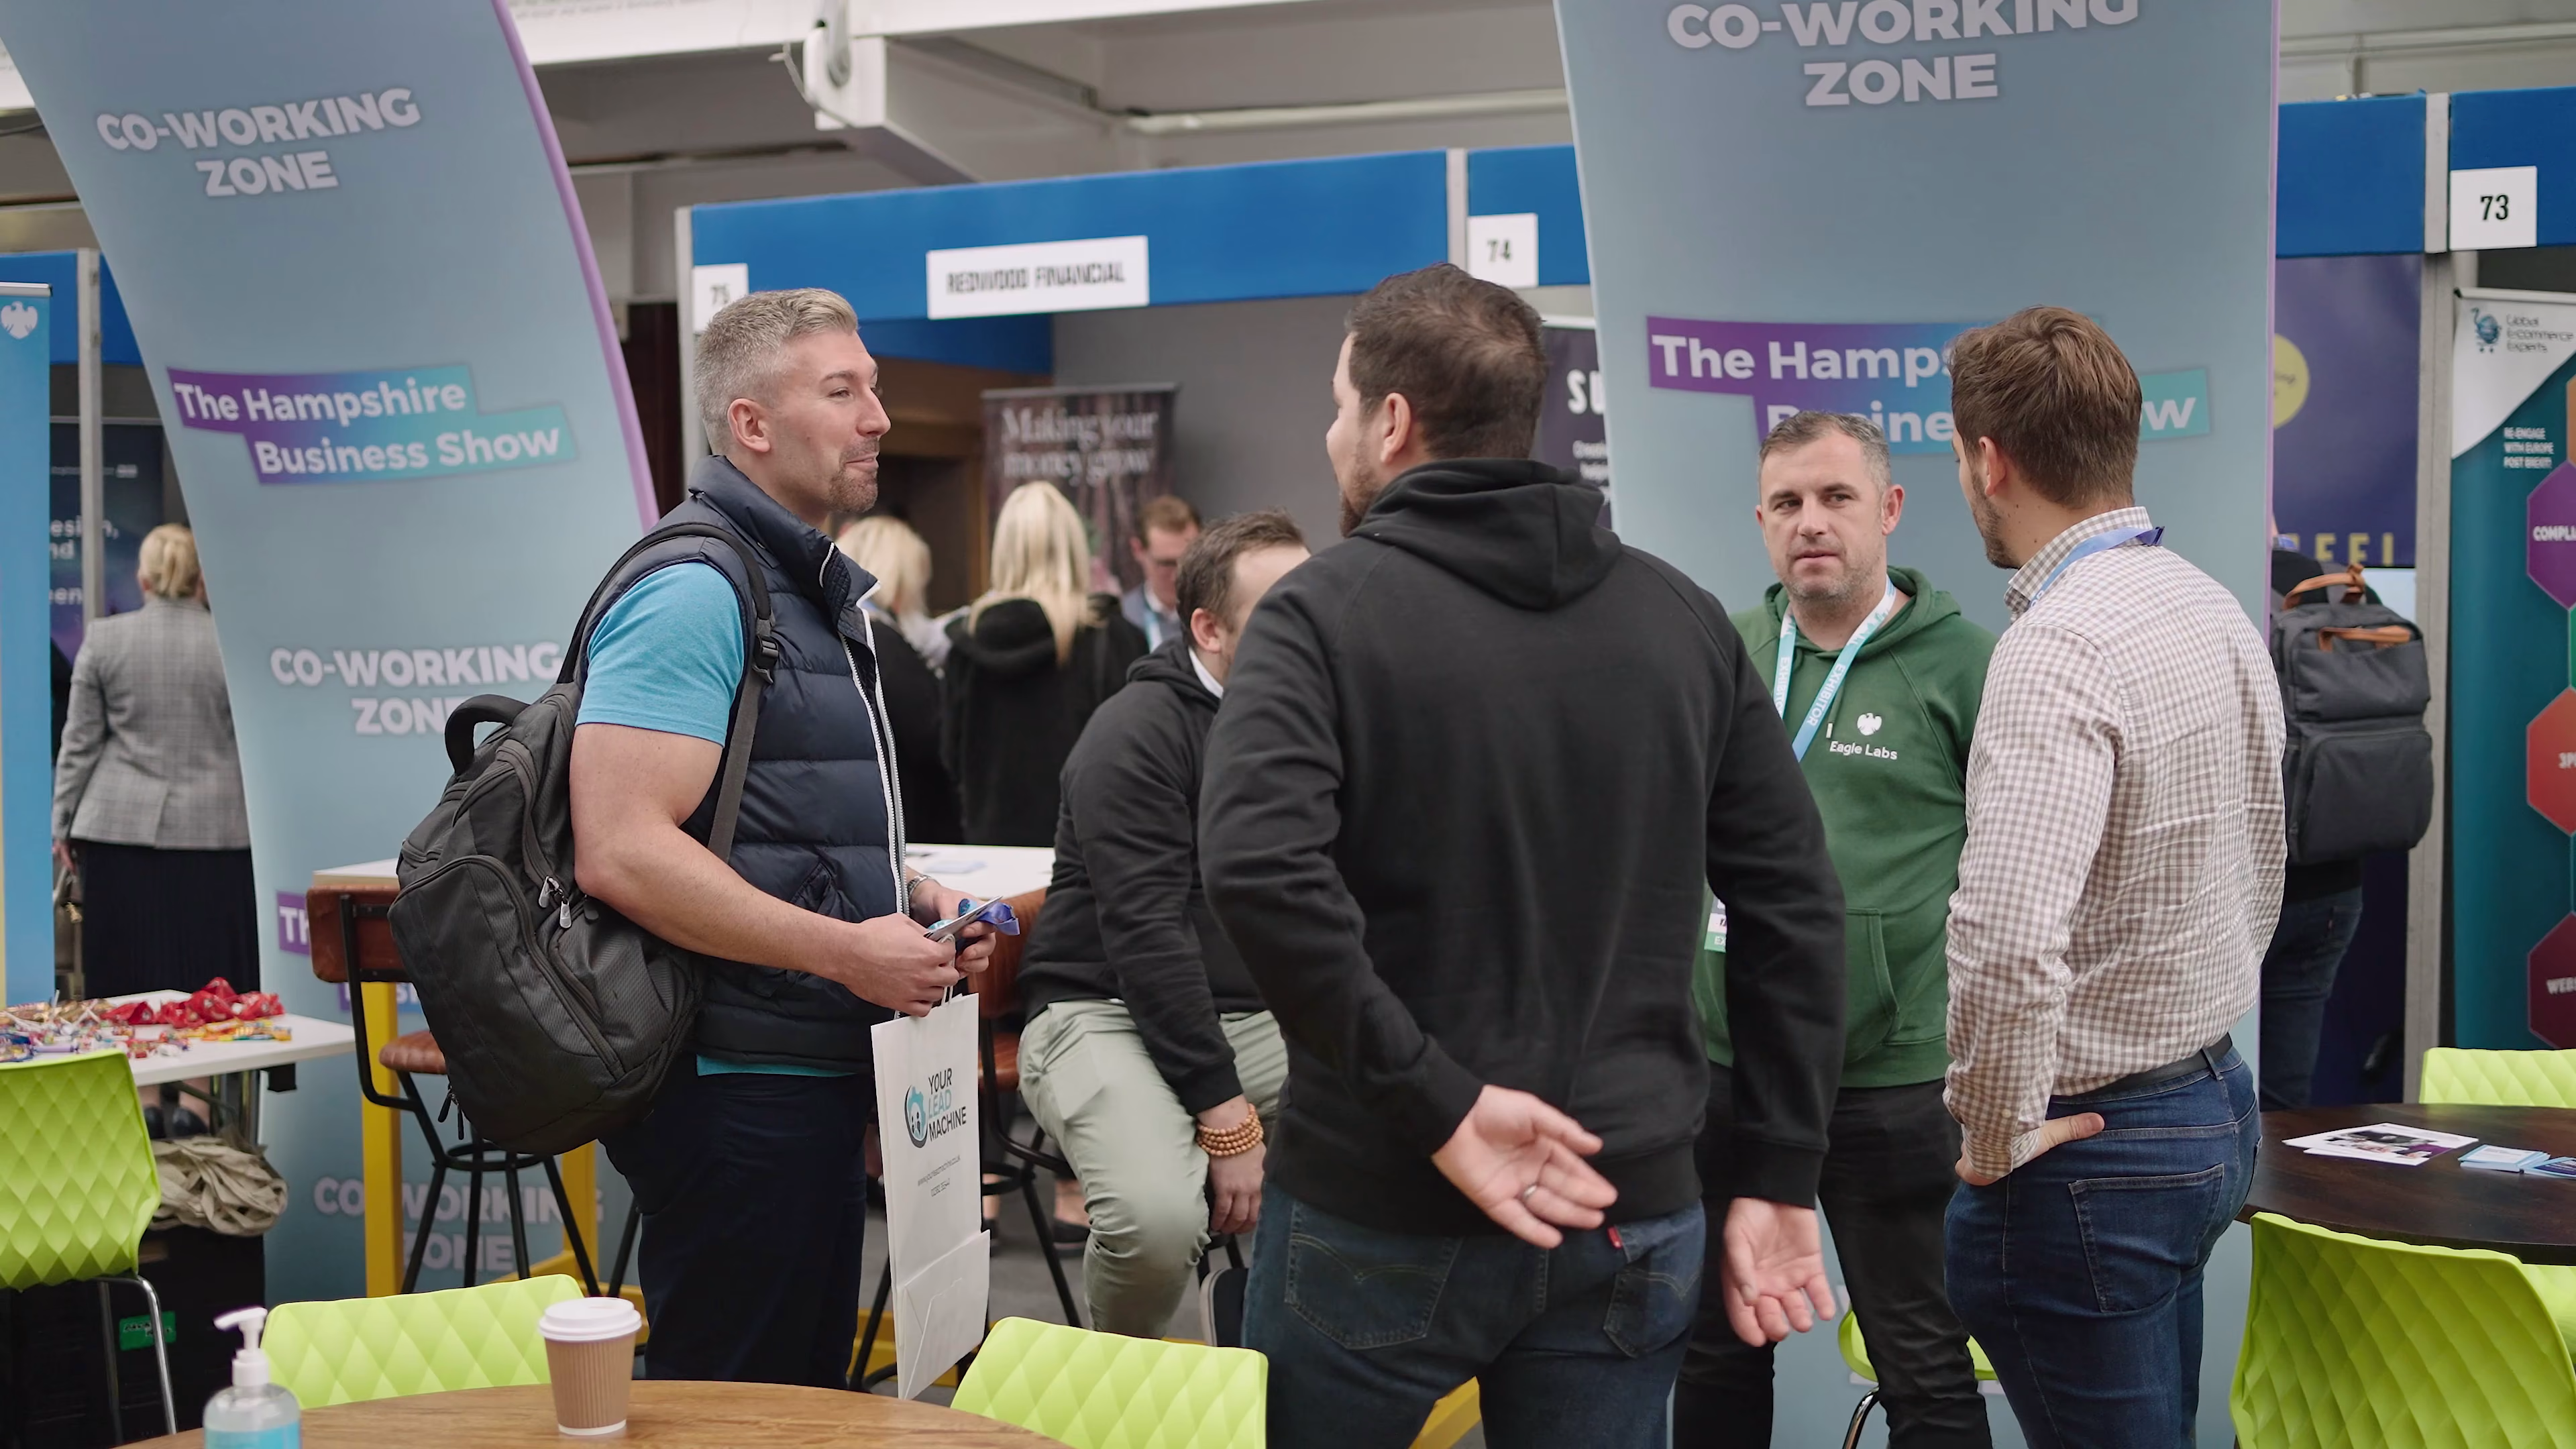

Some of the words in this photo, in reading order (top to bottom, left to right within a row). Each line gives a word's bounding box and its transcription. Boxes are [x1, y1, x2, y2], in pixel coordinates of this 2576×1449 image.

[1667, 0, 2139, 49] CO-WORKING
[1804, 53, 1998, 106] ZONE
[96, 88, 421, 151] CO-WORKING
[195, 151, 338, 197] ZONE
[2479, 194, 2510, 221] 73
[1487, 239, 1512, 262] 74
[947, 267, 1029, 294] REDWOOD
[1034, 262, 1125, 287] FINANCIAL
[1652, 335, 1756, 379] The
[174, 382, 239, 421] The
[243, 377, 466, 427] Hampshire
[254, 437, 429, 474] Business
[436, 427, 560, 468] Show
[1002, 407, 1101, 452] Making
[270, 641, 564, 687] CO-WORKING
[1807, 663, 1846, 727] EXHIBITOR
[1829, 741, 1863, 755] Eagle
[1865, 744, 1898, 760] Labs
[928, 1068, 953, 1095] YOUR
[928, 1089, 952, 1118] LEAD
[928, 1106, 967, 1142] MACHINE
